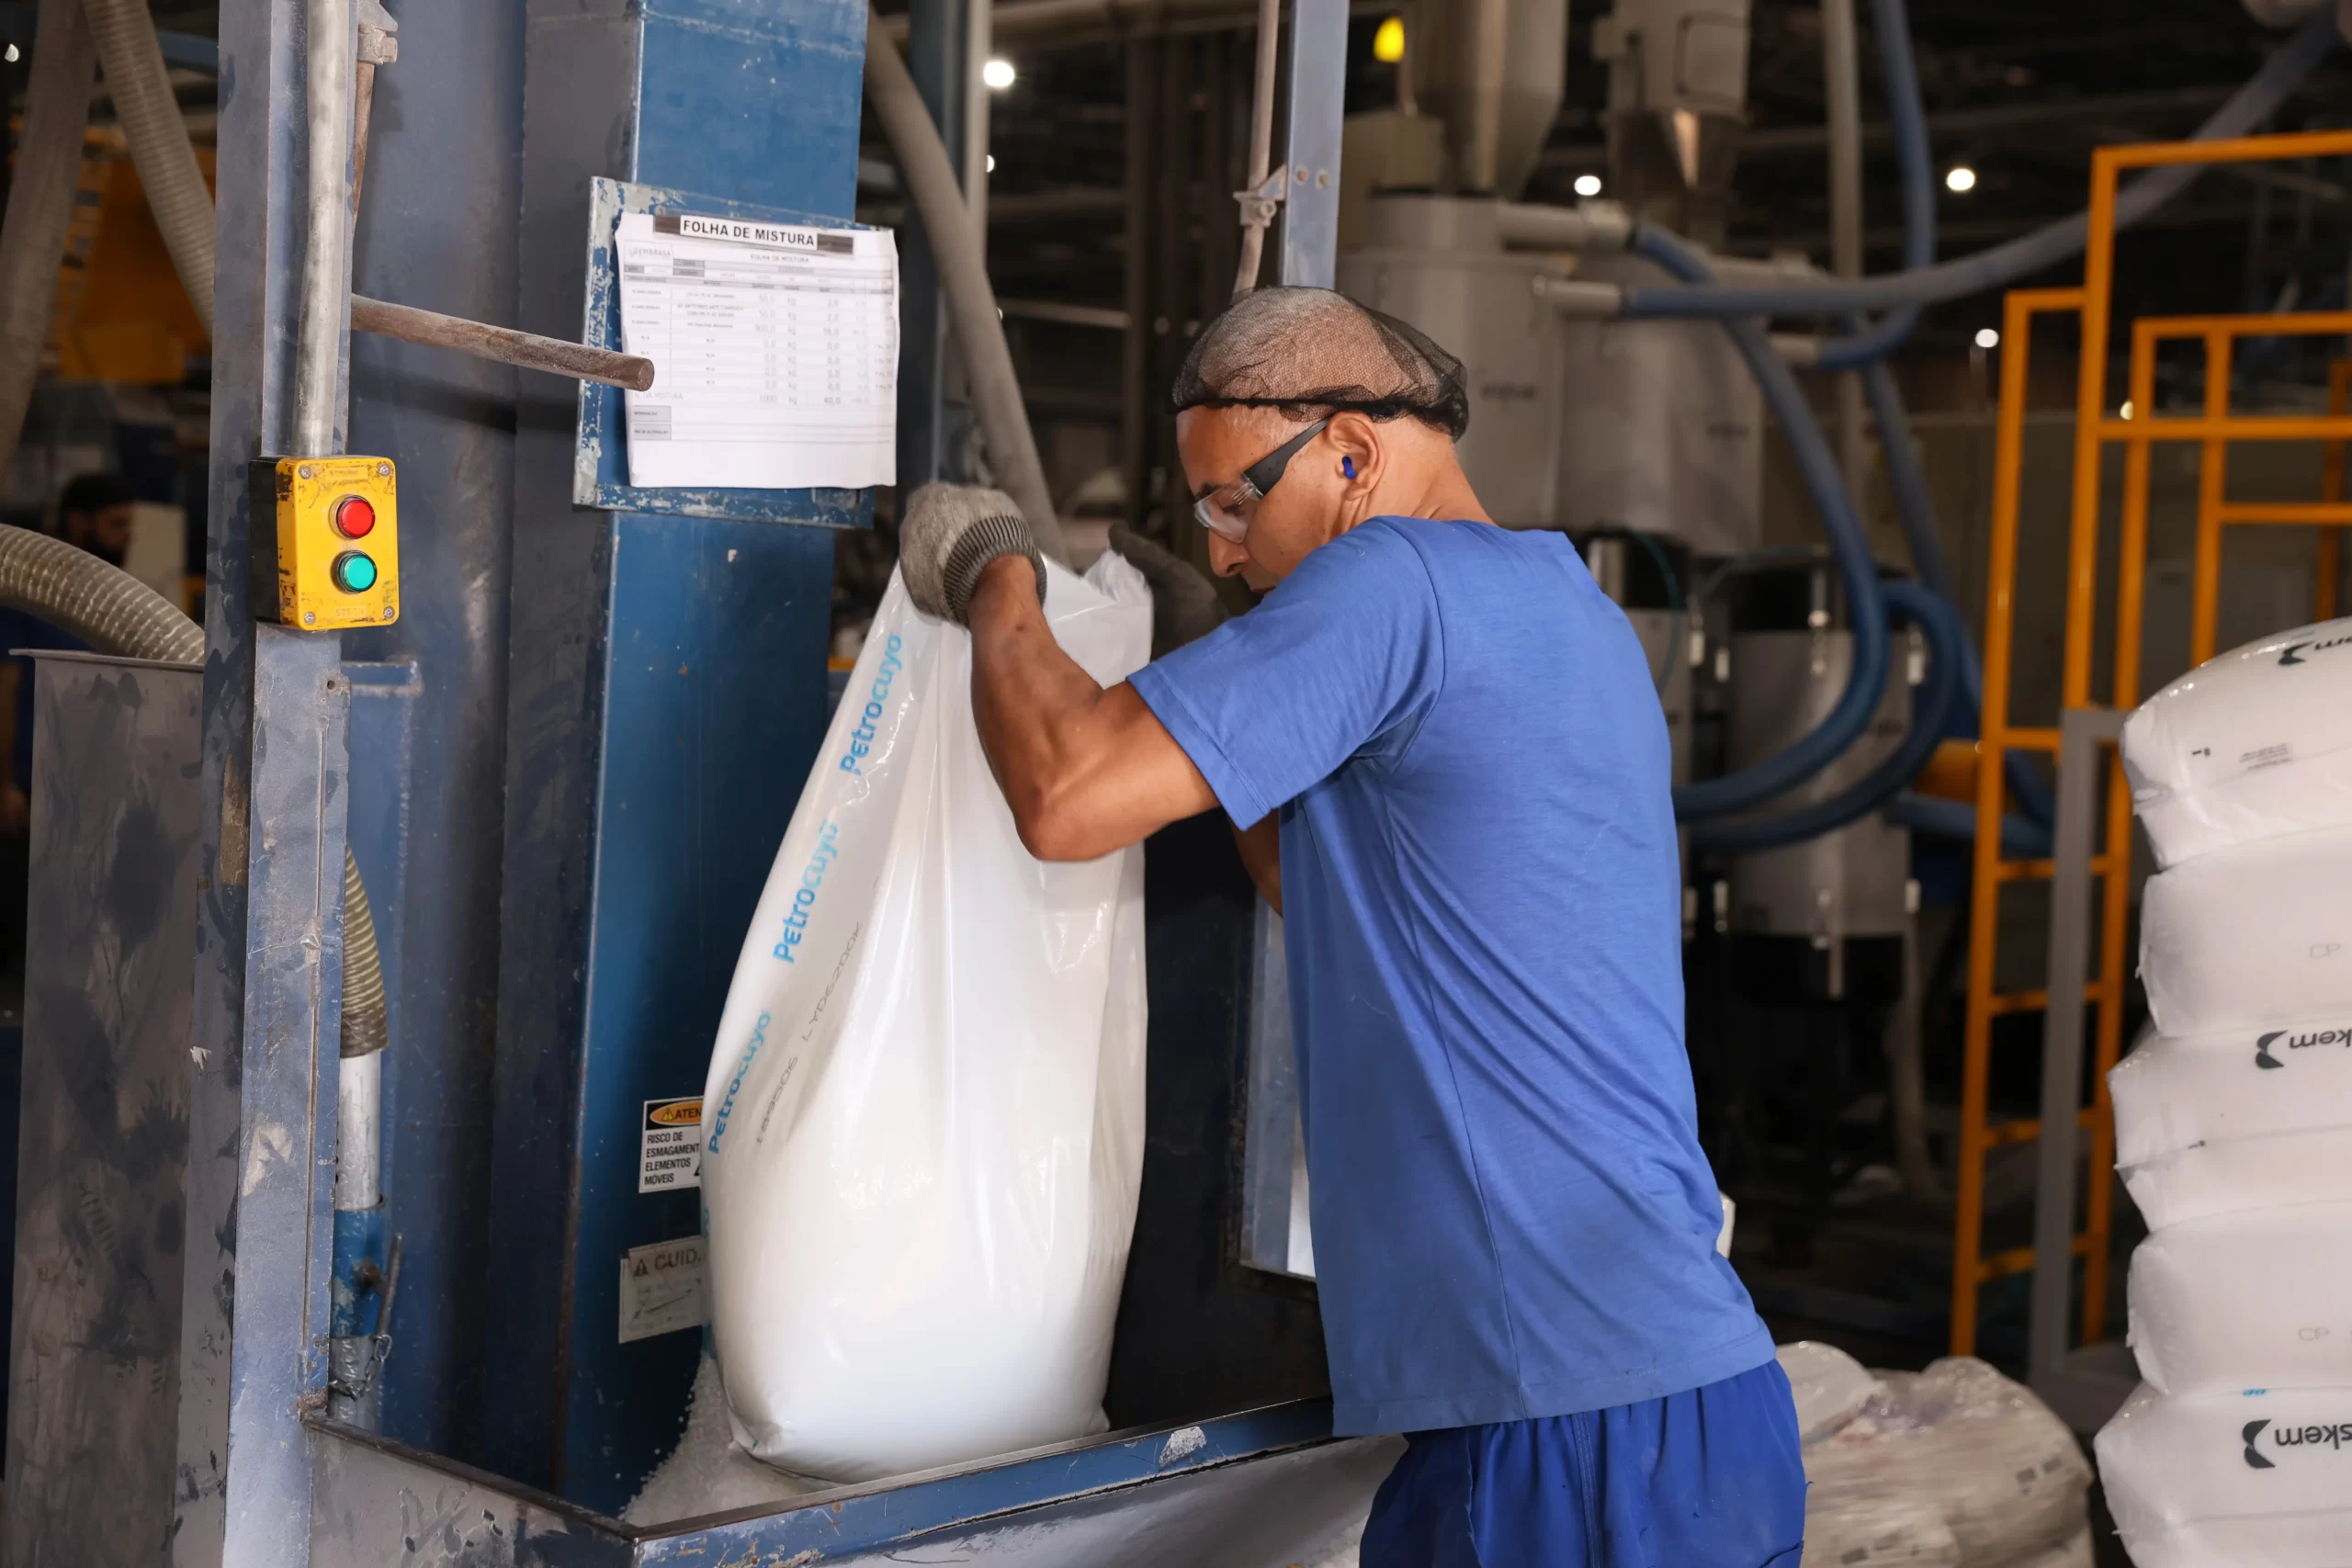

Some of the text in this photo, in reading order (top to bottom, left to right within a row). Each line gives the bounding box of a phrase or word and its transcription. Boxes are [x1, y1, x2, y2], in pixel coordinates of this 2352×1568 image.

[684, 220, 815, 246] FOLHA DE MISTURA
[839, 631, 902, 776] Petrocuyo
[773, 818, 838, 964] Petrocuyo
[2289, 1029, 2352, 1049] kem
[708, 1010, 771, 1154] Petrocuyo
[675, 1109, 702, 1119] ATEN
[647, 1131, 684, 1145] RISCO DE
[646, 1143, 700, 1157] ESMAGAMENT
[645, 1157, 692, 1172] ELEMENTOS
[654, 1248, 701, 1269] CUID
[2275, 1423, 2352, 1450] skem
